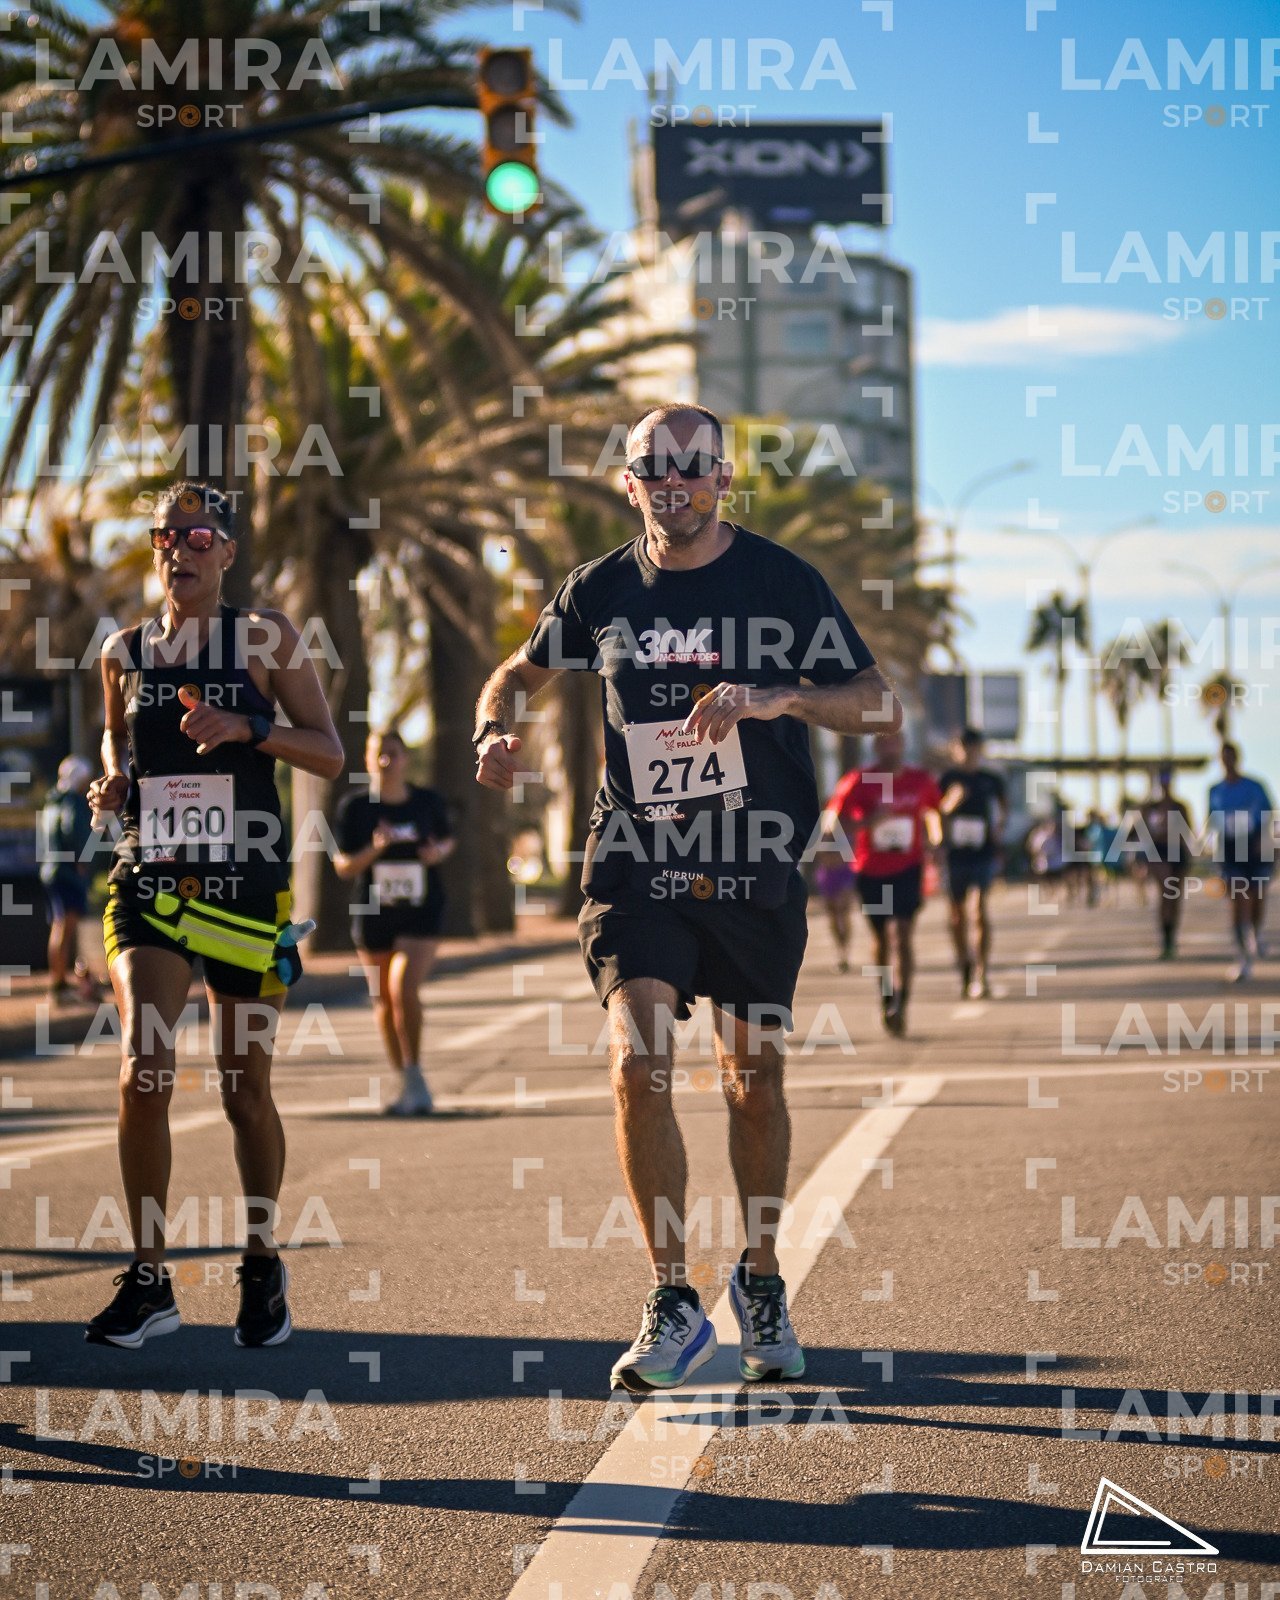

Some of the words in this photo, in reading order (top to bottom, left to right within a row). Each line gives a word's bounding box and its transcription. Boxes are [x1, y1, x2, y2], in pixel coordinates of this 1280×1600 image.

[635, 629, 714, 663] 30K
[648, 751, 725, 795] 274
[147, 806, 225, 838] 1160
[644, 803, 679, 822] 30K
[144, 846, 172, 863] 30K
[662, 869, 704, 881] KIPRUN
